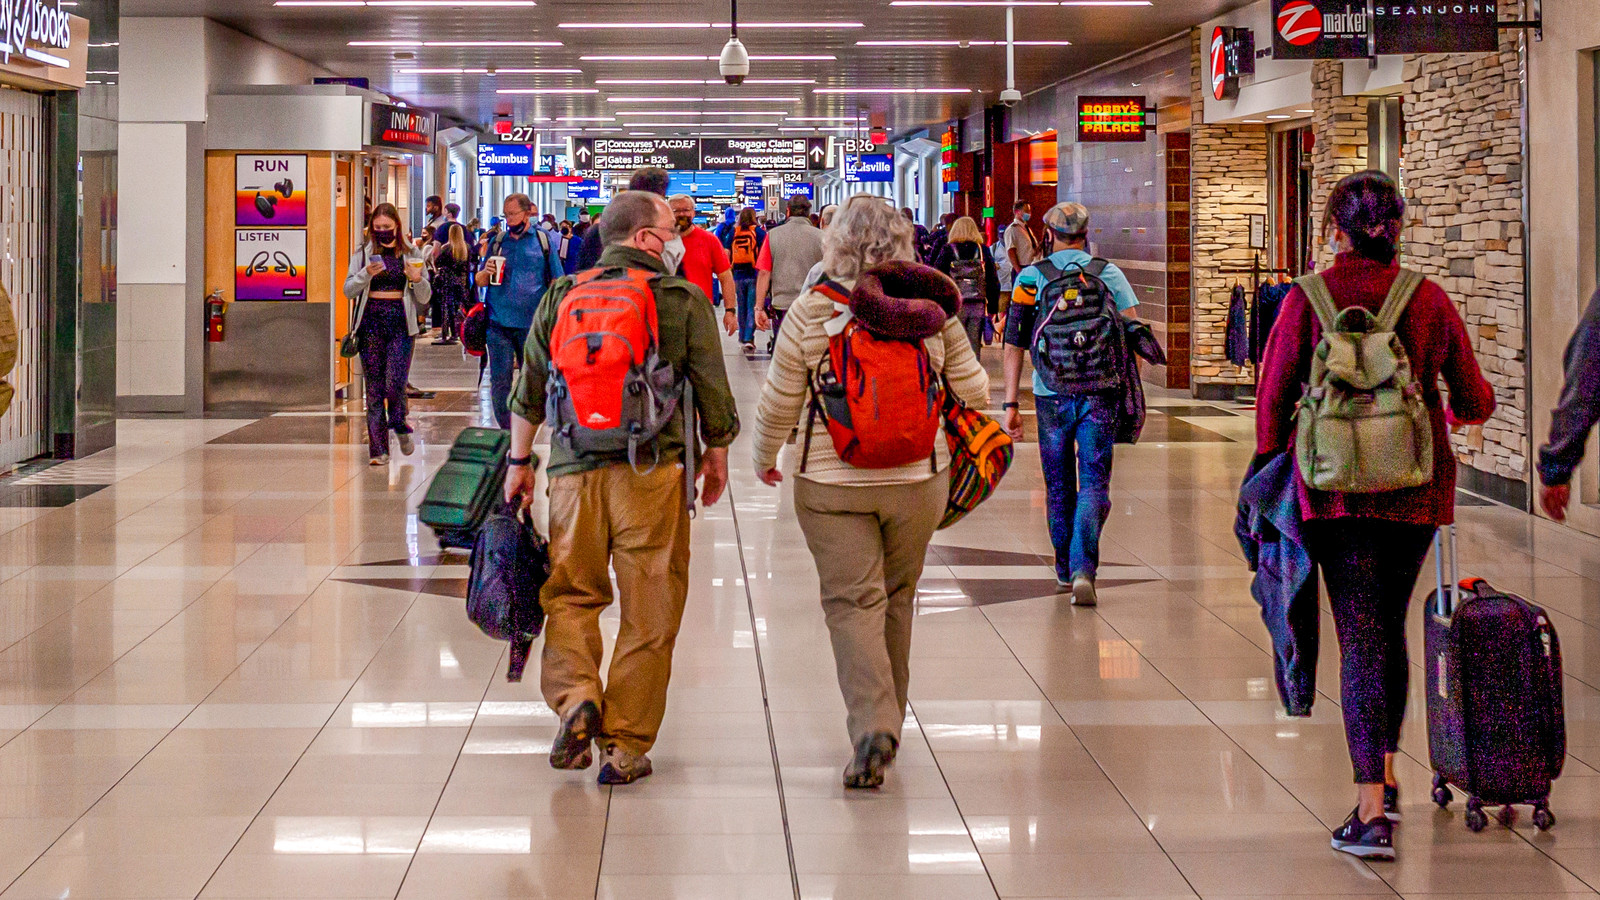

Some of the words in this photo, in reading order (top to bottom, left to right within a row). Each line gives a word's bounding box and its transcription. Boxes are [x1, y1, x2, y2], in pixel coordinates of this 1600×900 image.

[1323, 4, 1367, 33] market
[1083, 101, 1140, 113] BOBBY'S
[1083, 124, 1140, 132] PALACE
[501, 127, 533, 141] B27
[607, 140, 653, 148] Concourses
[728, 140, 767, 149] Baggage
[768, 140, 792, 148] Claim
[845, 139, 875, 151] B26
[478, 153, 529, 163] Columbus
[607, 156, 632, 164] Gates
[633, 156, 643, 164] B1
[651, 156, 668, 164] B26
[704, 155, 734, 164] Ground
[736, 155, 792, 165] Transportation
[254, 160, 289, 172] RUN
[784, 173, 802, 181] B24
[784, 186, 810, 195] Norfolk
[239, 232, 280, 241] LISTEN
